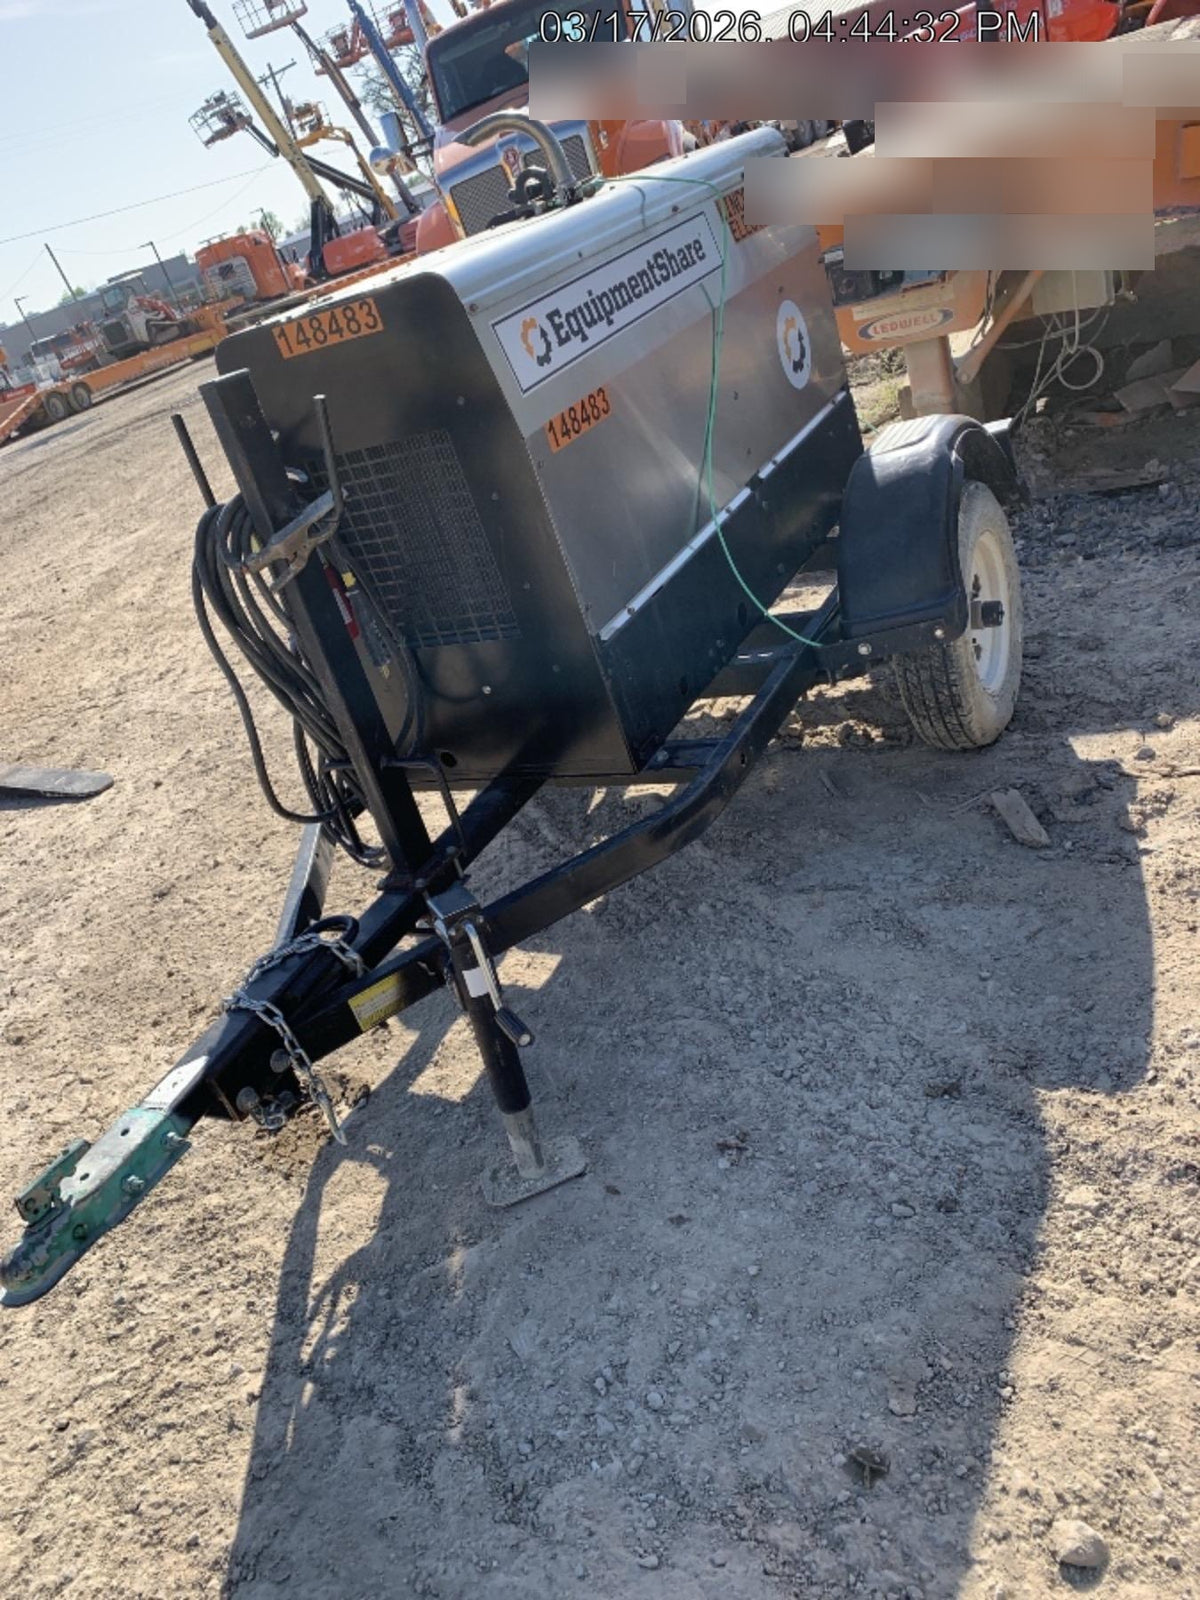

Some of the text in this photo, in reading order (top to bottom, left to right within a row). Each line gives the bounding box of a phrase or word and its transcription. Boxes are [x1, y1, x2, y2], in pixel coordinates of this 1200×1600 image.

[546, 238, 706, 347] EquipmentShare
[277, 300, 379, 354] 148483
[873, 314, 938, 334] LEDWELL
[548, 387, 610, 448] 148483
